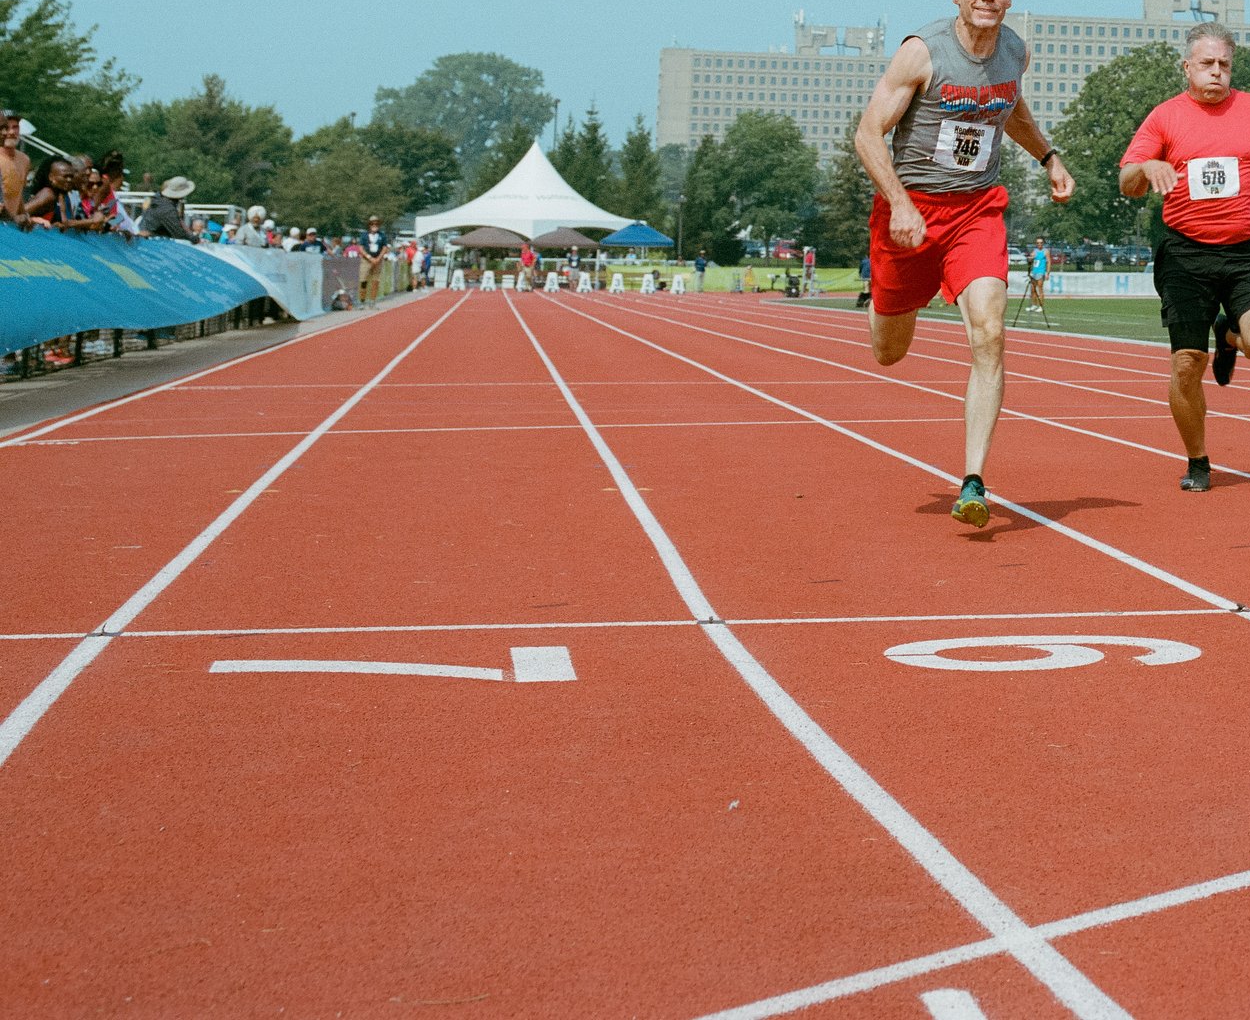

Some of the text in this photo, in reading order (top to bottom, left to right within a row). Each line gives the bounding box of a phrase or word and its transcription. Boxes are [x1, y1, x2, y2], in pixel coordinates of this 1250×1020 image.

[953, 138, 981, 157] 746
[1202, 170, 1226, 186] 578
[208, 645, 578, 684] 7
[883, 635, 1202, 671] 6
